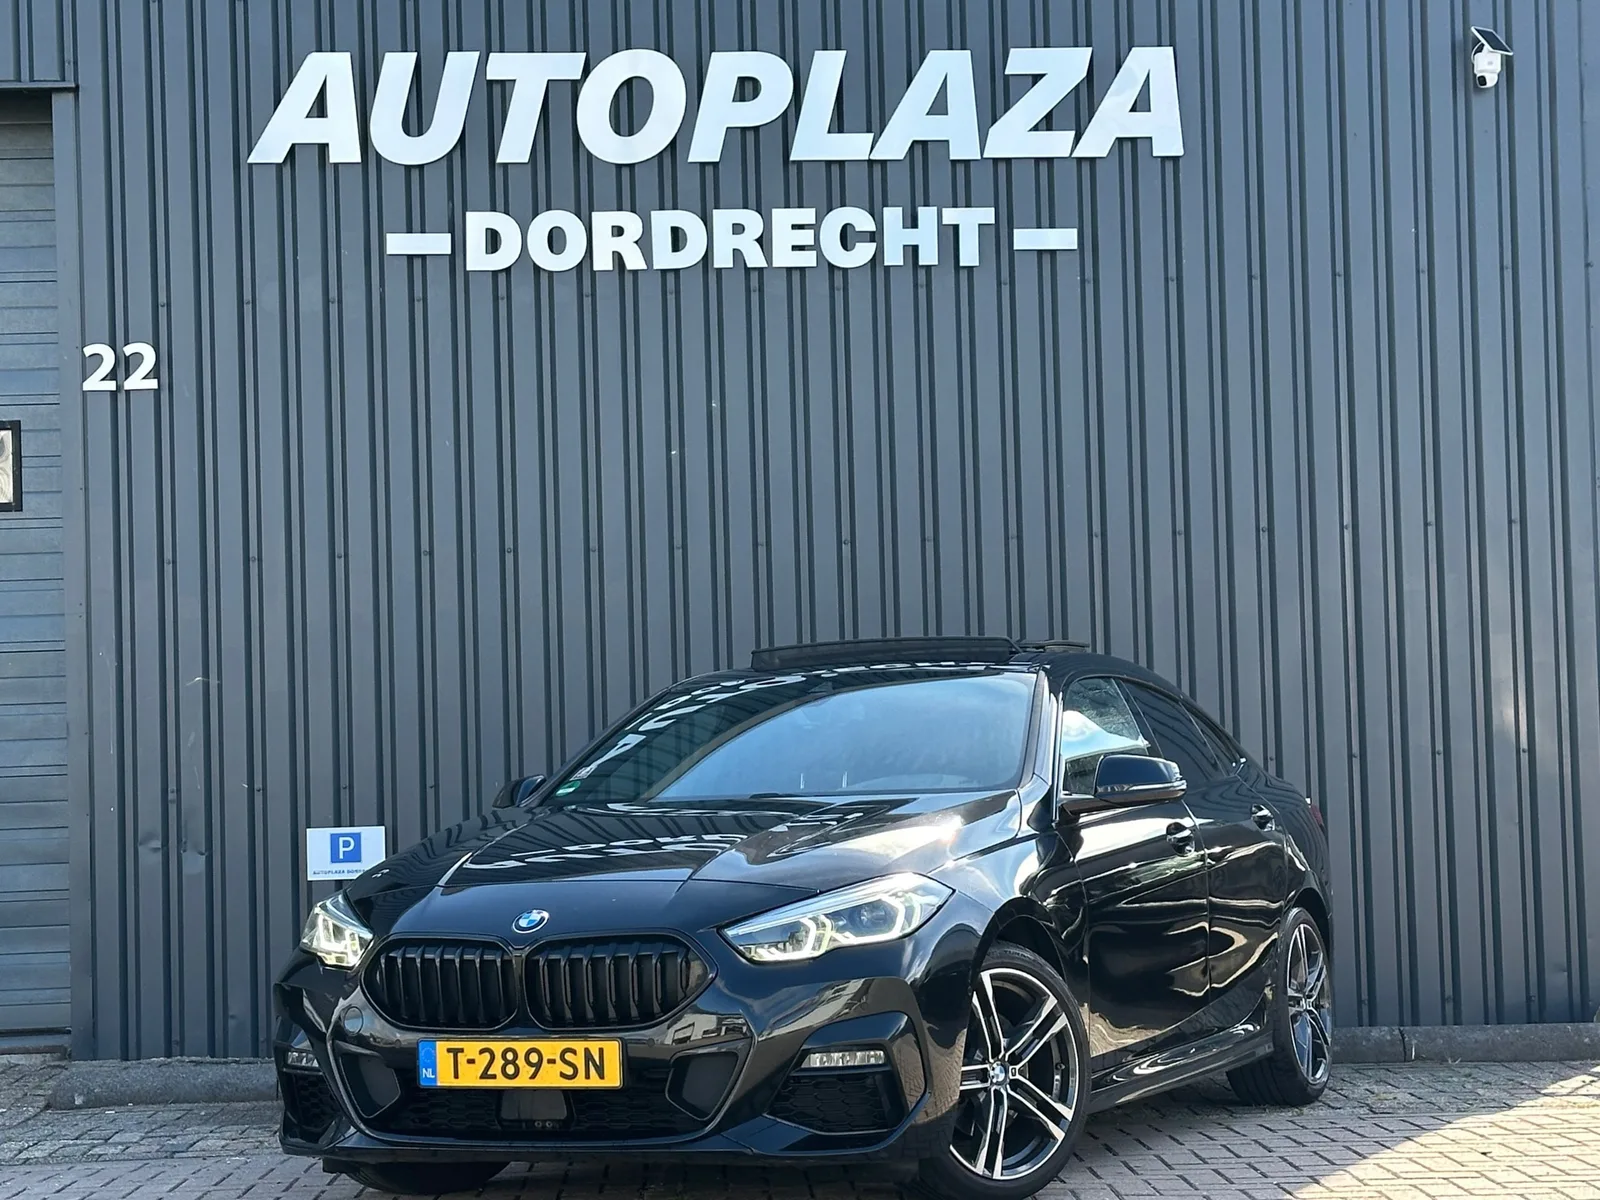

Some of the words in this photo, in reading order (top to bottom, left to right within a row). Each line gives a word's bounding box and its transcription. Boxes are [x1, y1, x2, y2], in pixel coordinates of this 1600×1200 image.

[246, 46, 1185, 166] AUTOPLAZA
[465, 206, 996, 272] DORDRECHT
[82, 342, 159, 392] 22
[338, 836, 355, 860] P
[422, 1068, 435, 1079] NL
[446, 1046, 605, 1081] T-289-SN
